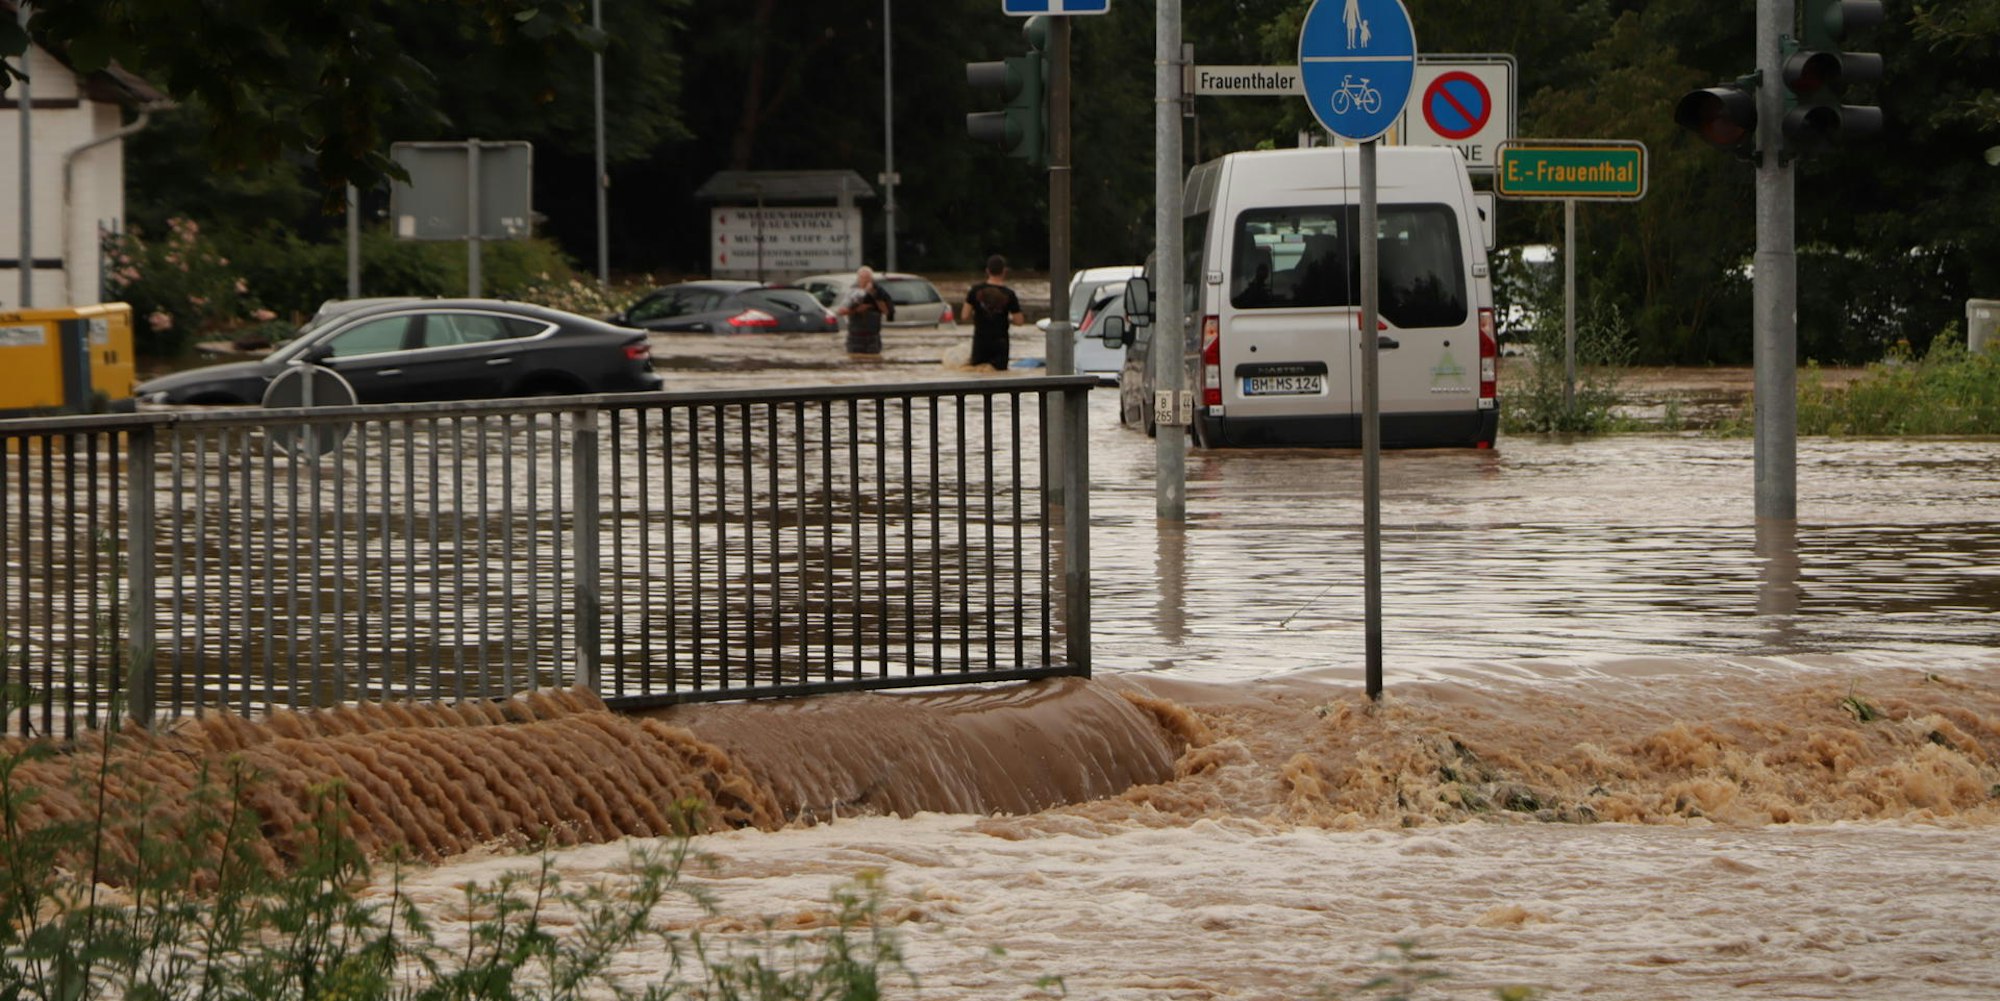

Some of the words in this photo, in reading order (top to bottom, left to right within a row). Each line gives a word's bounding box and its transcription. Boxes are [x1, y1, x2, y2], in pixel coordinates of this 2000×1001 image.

[1201, 72, 1296, 89] Frauenthaler
[1252, 379, 1268, 391] BM
[1276, 378, 1293, 390] MS
[1296, 377, 1318, 390] 124
[1156, 410, 1172, 422] 265
